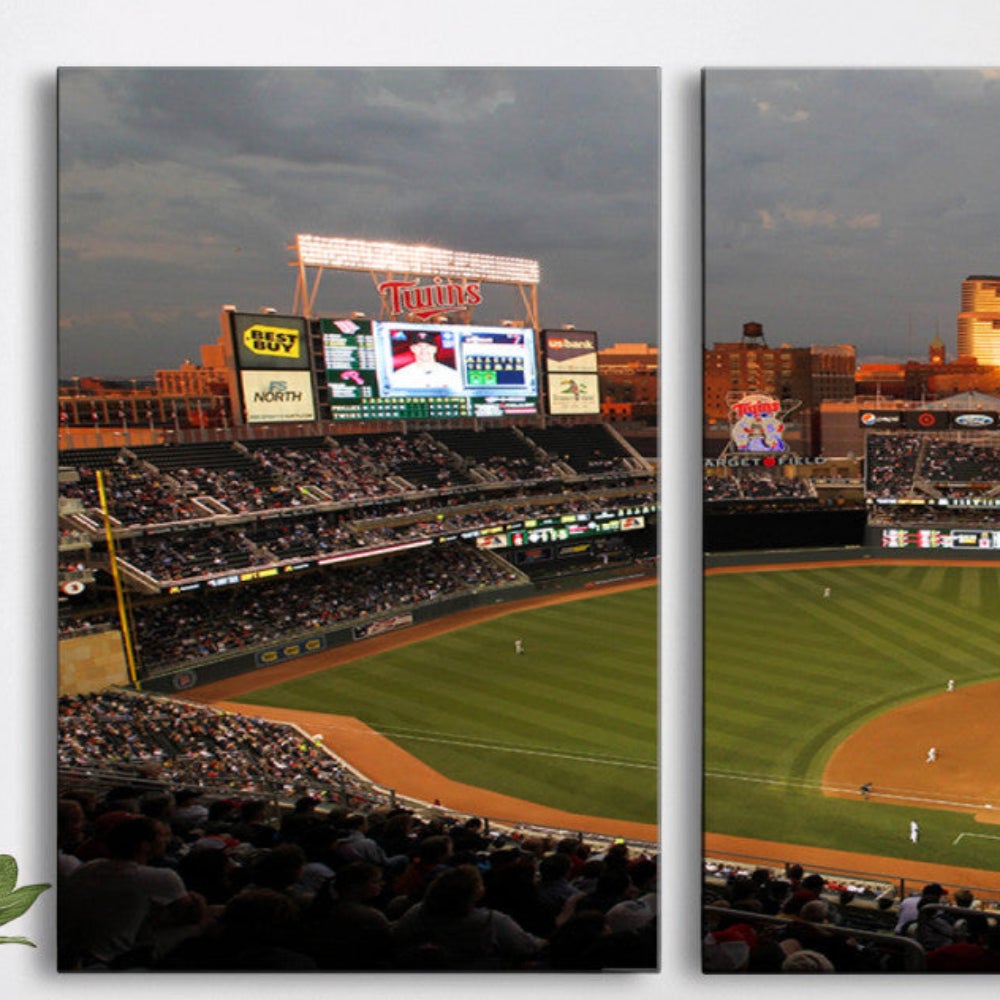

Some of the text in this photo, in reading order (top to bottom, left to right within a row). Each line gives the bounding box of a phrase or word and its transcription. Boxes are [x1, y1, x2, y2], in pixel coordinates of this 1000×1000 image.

[378, 276, 483, 316] Twins
[251, 330, 297, 343] BEST
[253, 340, 296, 352] BUY
[254, 391, 303, 403] NORTH
